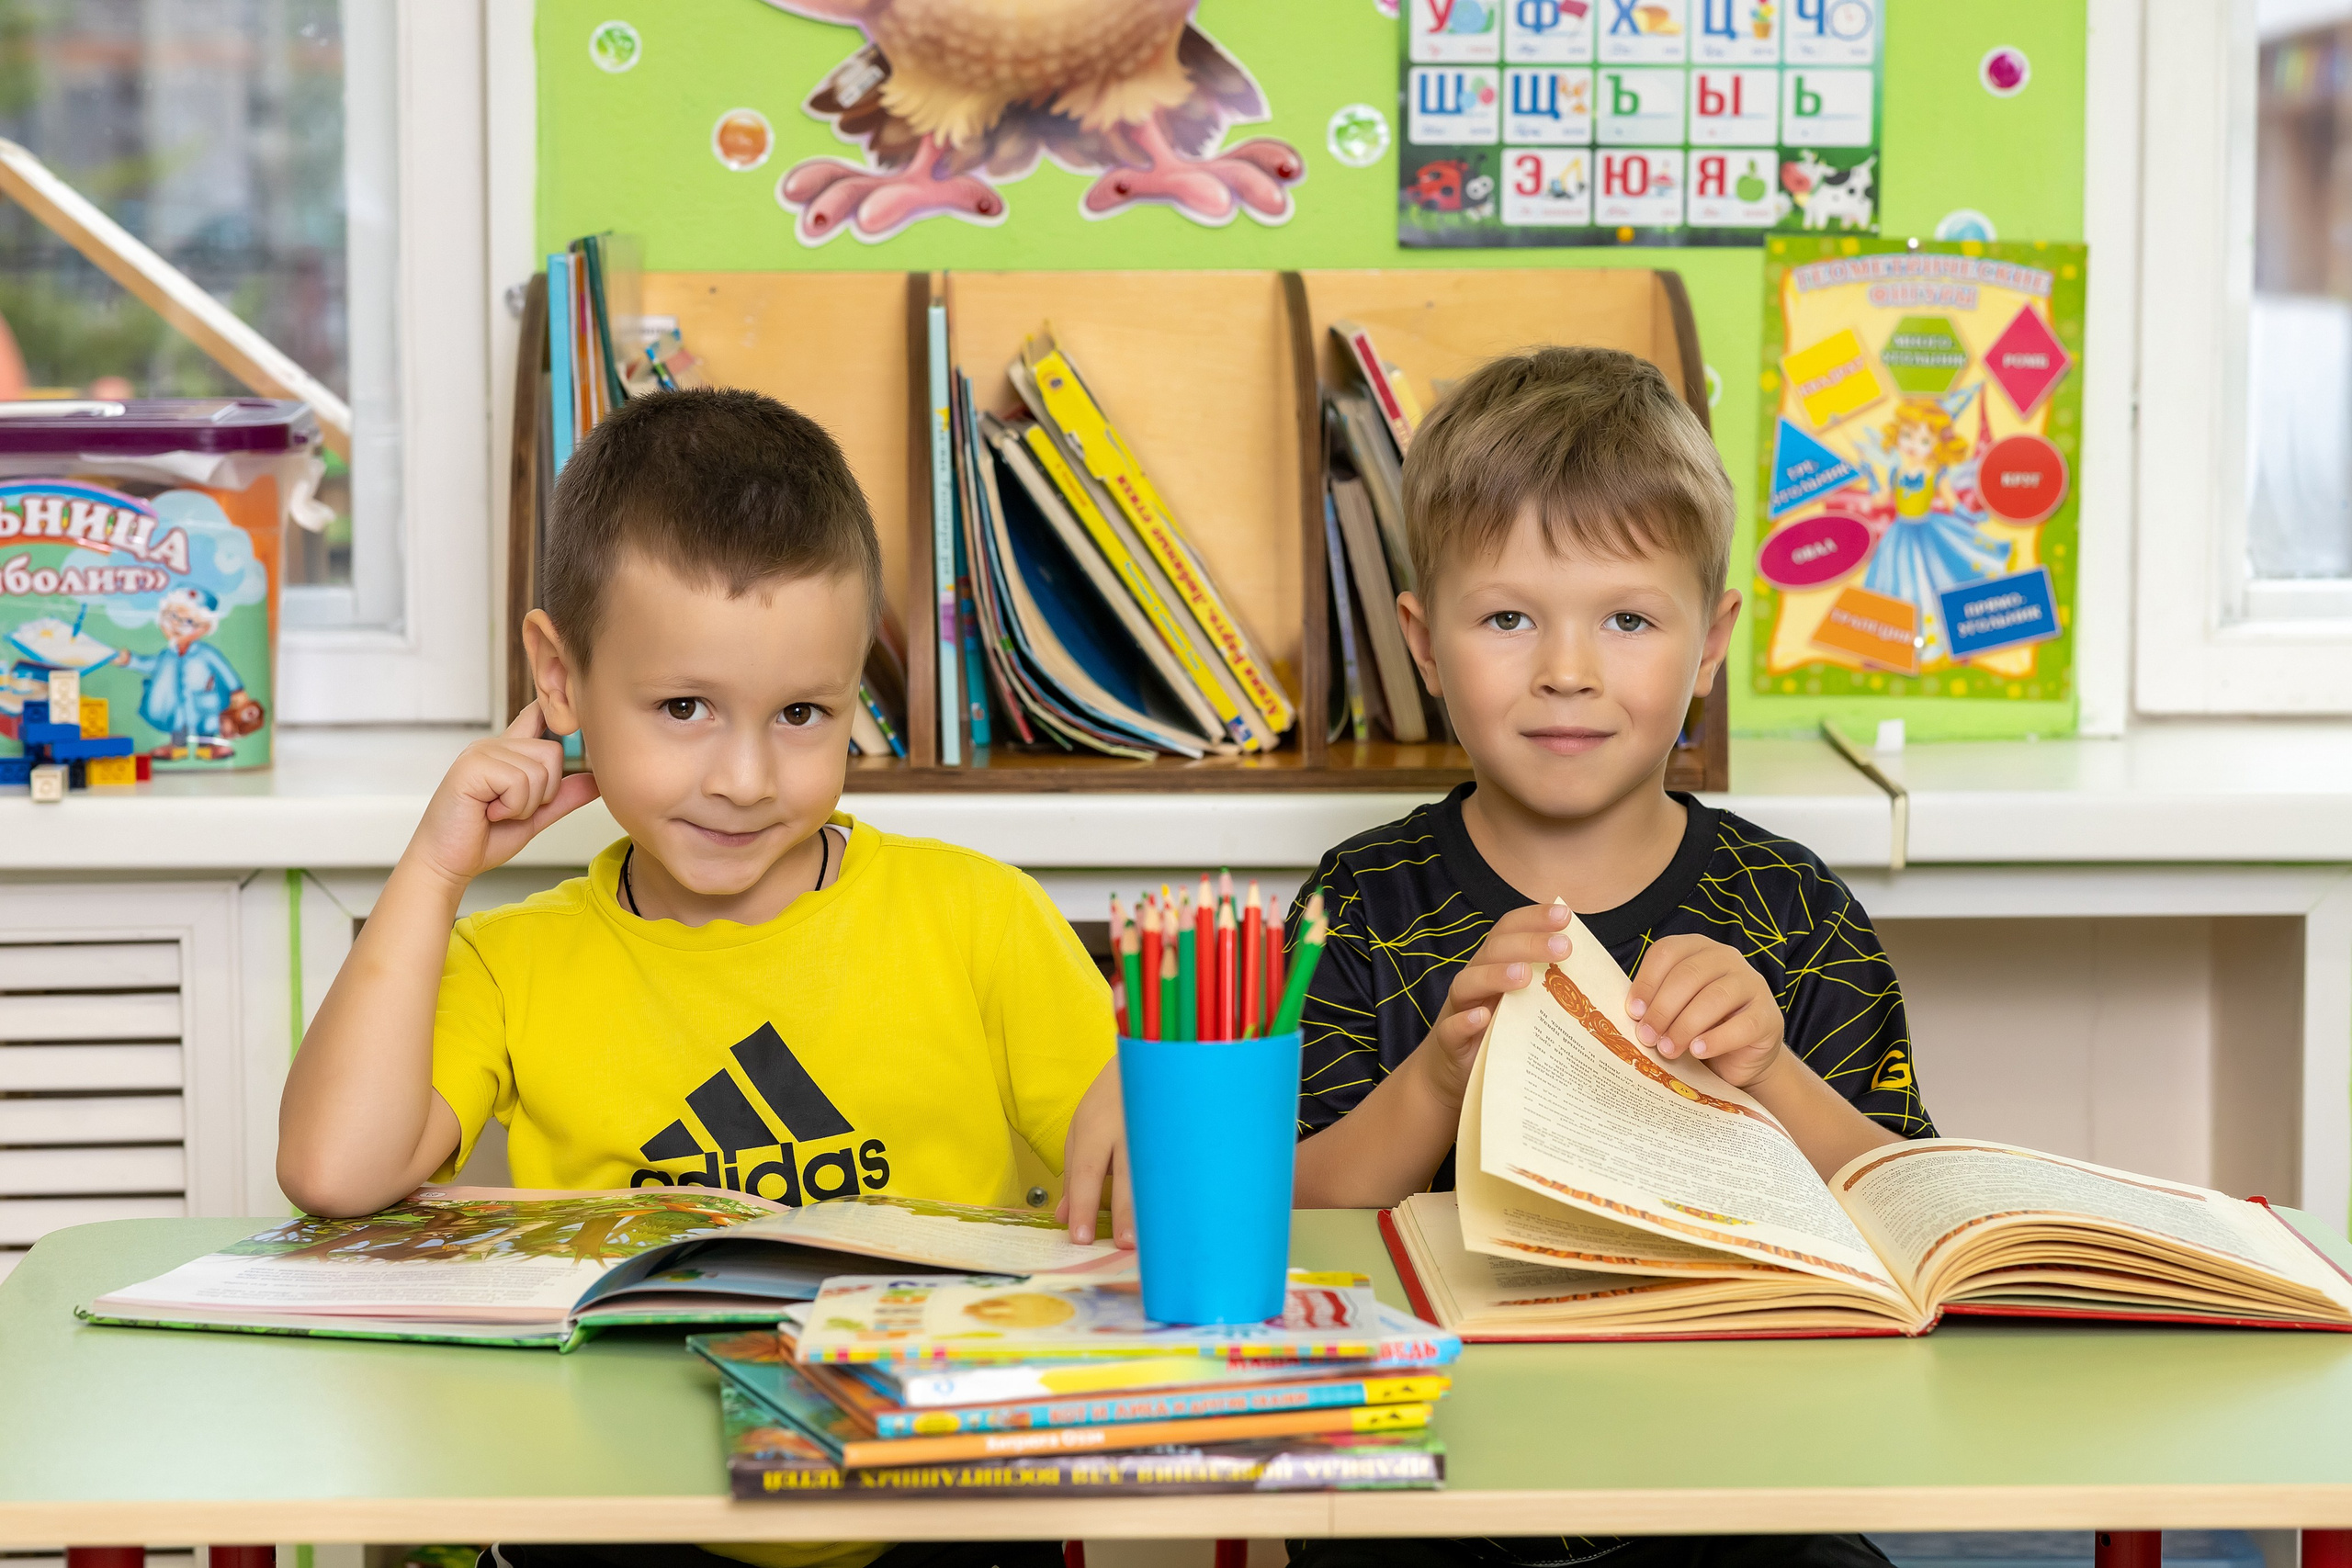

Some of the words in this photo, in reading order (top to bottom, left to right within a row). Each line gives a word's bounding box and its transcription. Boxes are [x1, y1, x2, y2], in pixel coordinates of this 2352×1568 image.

[1516, 0, 1561, 34] Ф
[1703, 0, 1736, 39] Ц
[1797, 0, 1826, 35] Ч
[1419, 73, 1464, 115] Ш
[1512, 73, 1560, 120] Щ
[1605, 74, 1640, 116] Ъ
[1698, 75, 1742, 117] Ы
[1794, 75, 1823, 118] Ь
[1514, 154, 1543, 197] Э
[1603, 155, 1649, 197] Ю
[1696, 155, 1726, 197] Я
